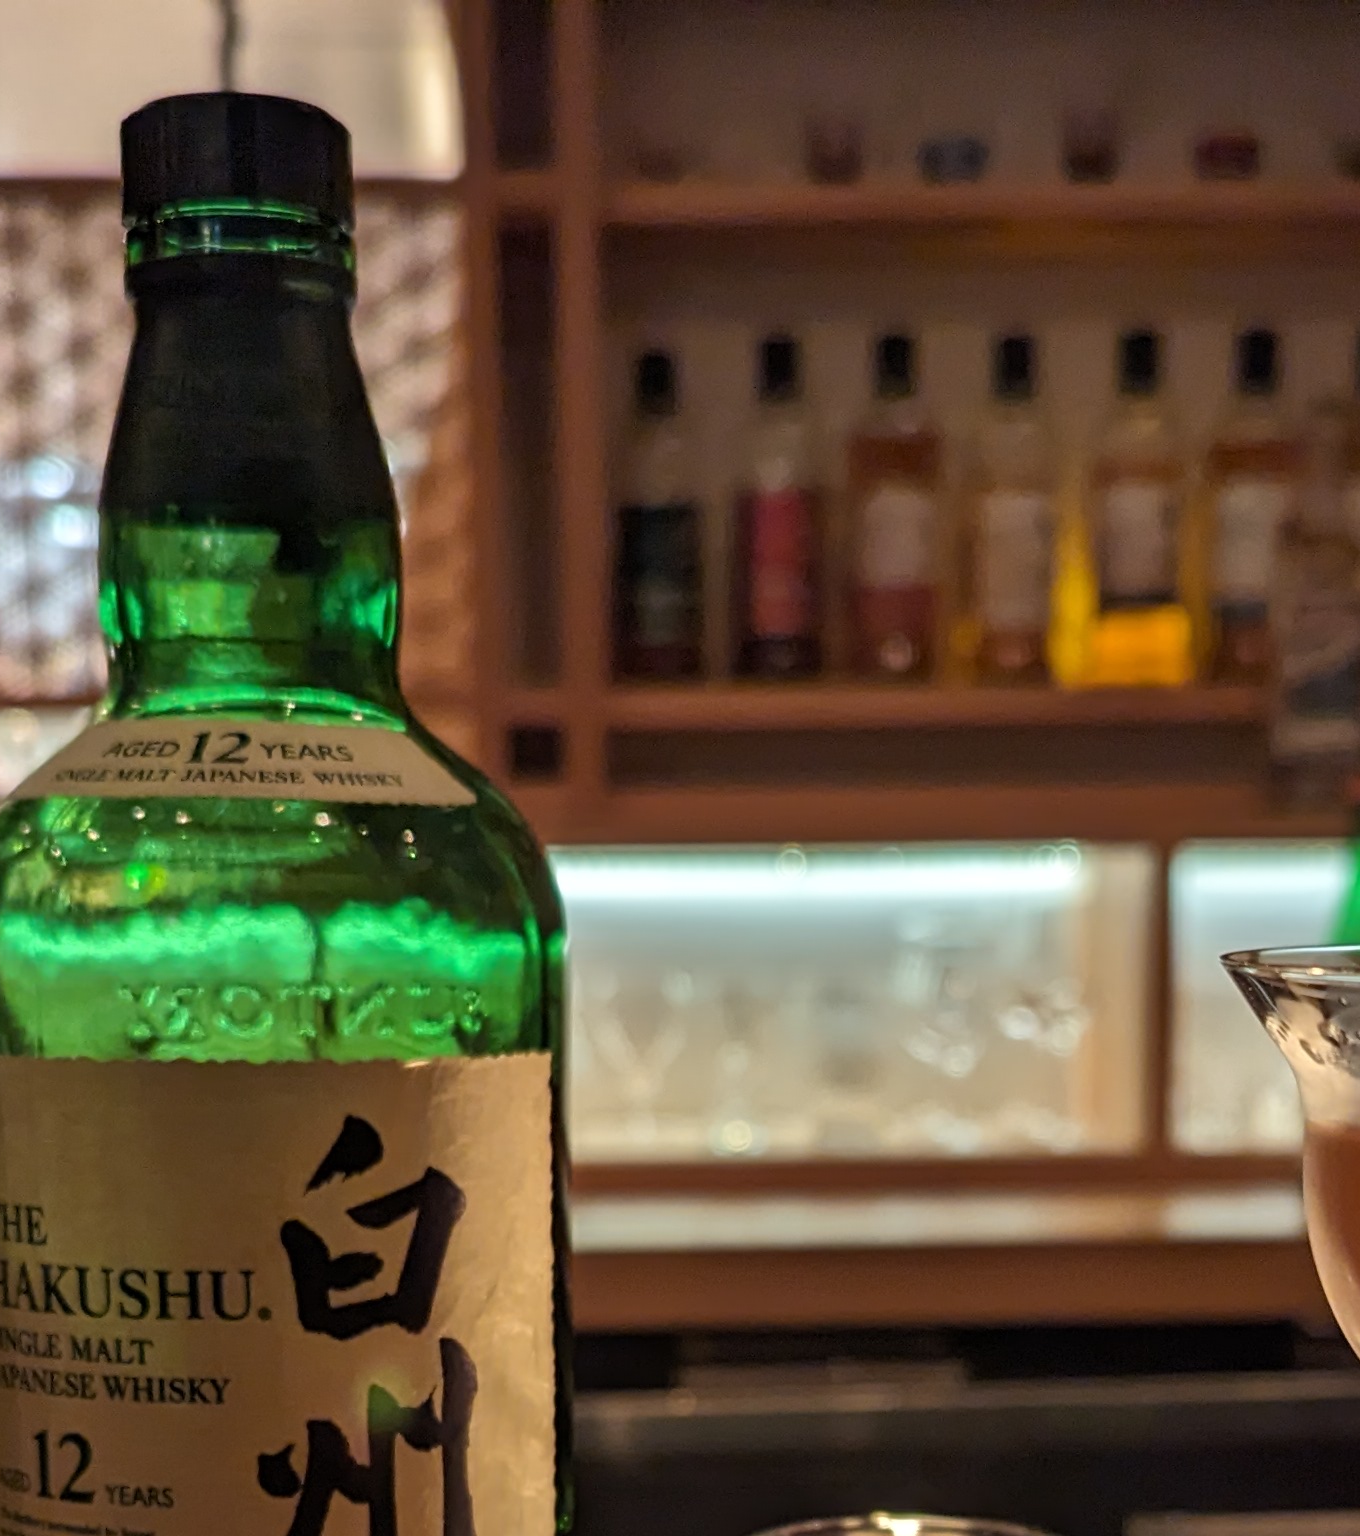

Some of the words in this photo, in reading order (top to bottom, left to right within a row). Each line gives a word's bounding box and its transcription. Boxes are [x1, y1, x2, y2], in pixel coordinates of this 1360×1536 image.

[103, 740, 181, 760] AGED
[185, 730, 253, 765] 12
[260, 742, 354, 763] YEARS
[115, 768, 178, 784] MALT
[180, 769, 305, 786] JAPANESE
[314, 771, 404, 789] WHISKY
[70, 1335, 154, 1366] MALT
[103, 1374, 231, 1406] WHISKY
[31, 1429, 96, 1504] 12
[106, 1483, 174, 1509] YEARS
